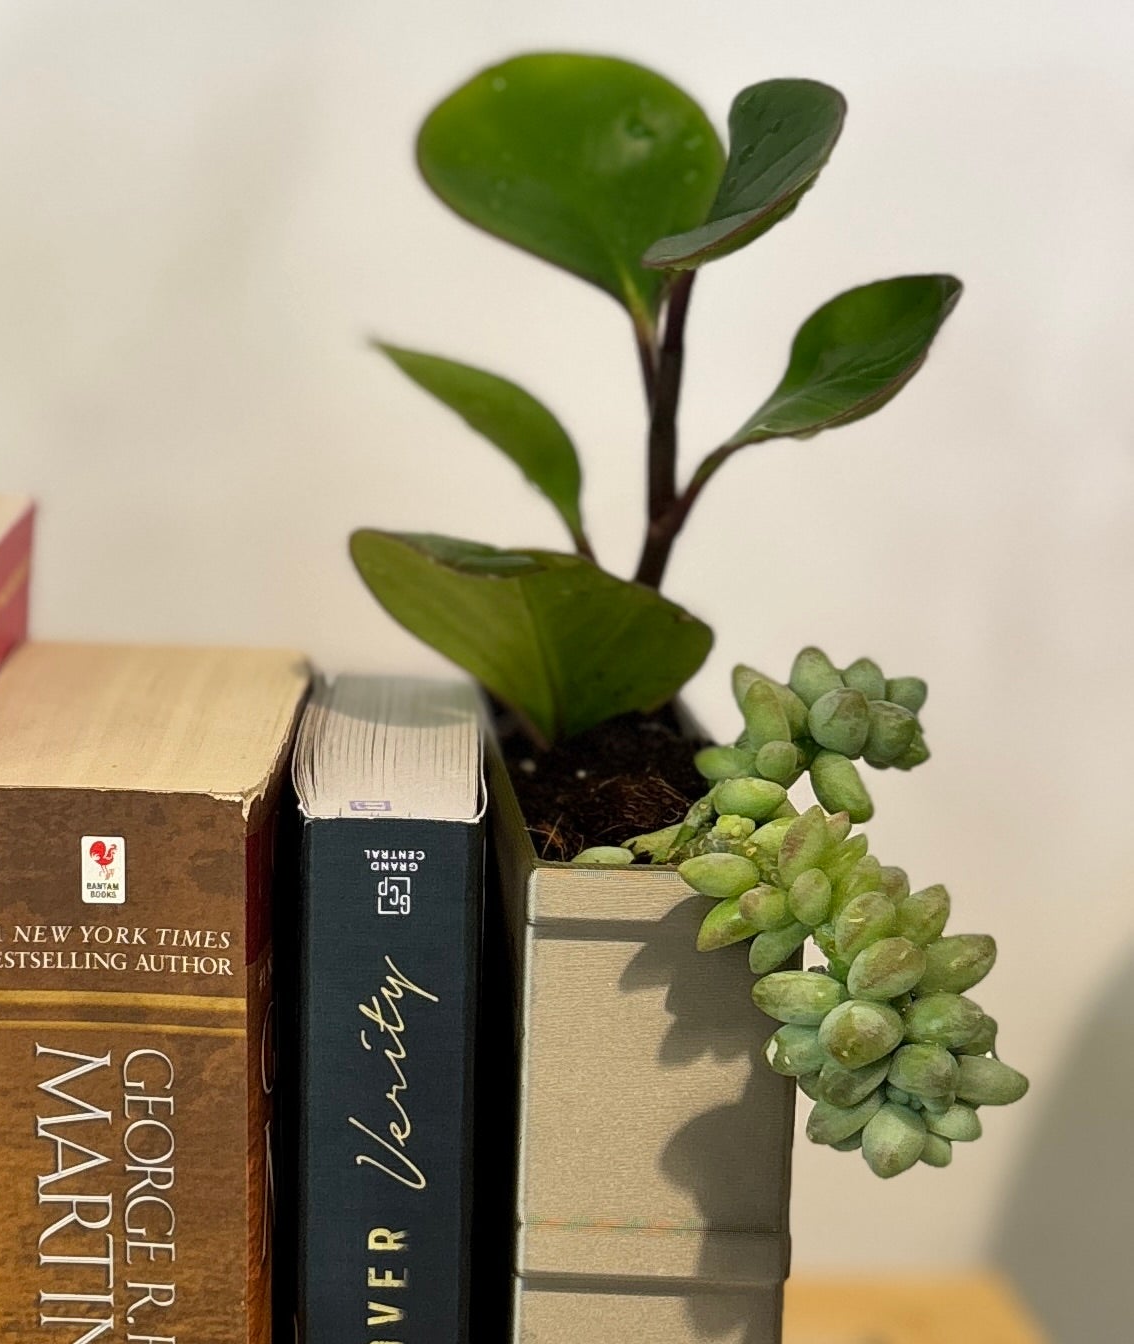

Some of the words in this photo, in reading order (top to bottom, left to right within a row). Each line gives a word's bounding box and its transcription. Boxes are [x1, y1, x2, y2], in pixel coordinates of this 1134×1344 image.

[363, 849, 426, 860] CENTRAL
[370, 861, 419, 872] GRAND
[86, 882, 120, 891] BANTAM
[90, 890, 117, 899] BOOKS
[13, 925, 74, 944] NEW
[80, 926, 149, 945] YORK
[156, 928, 232, 950] TIMES
[135, 953, 234, 976] AUTHOR
[349, 955, 440, 1190] Verity
[122, 1048, 176, 1265] GEORGE
